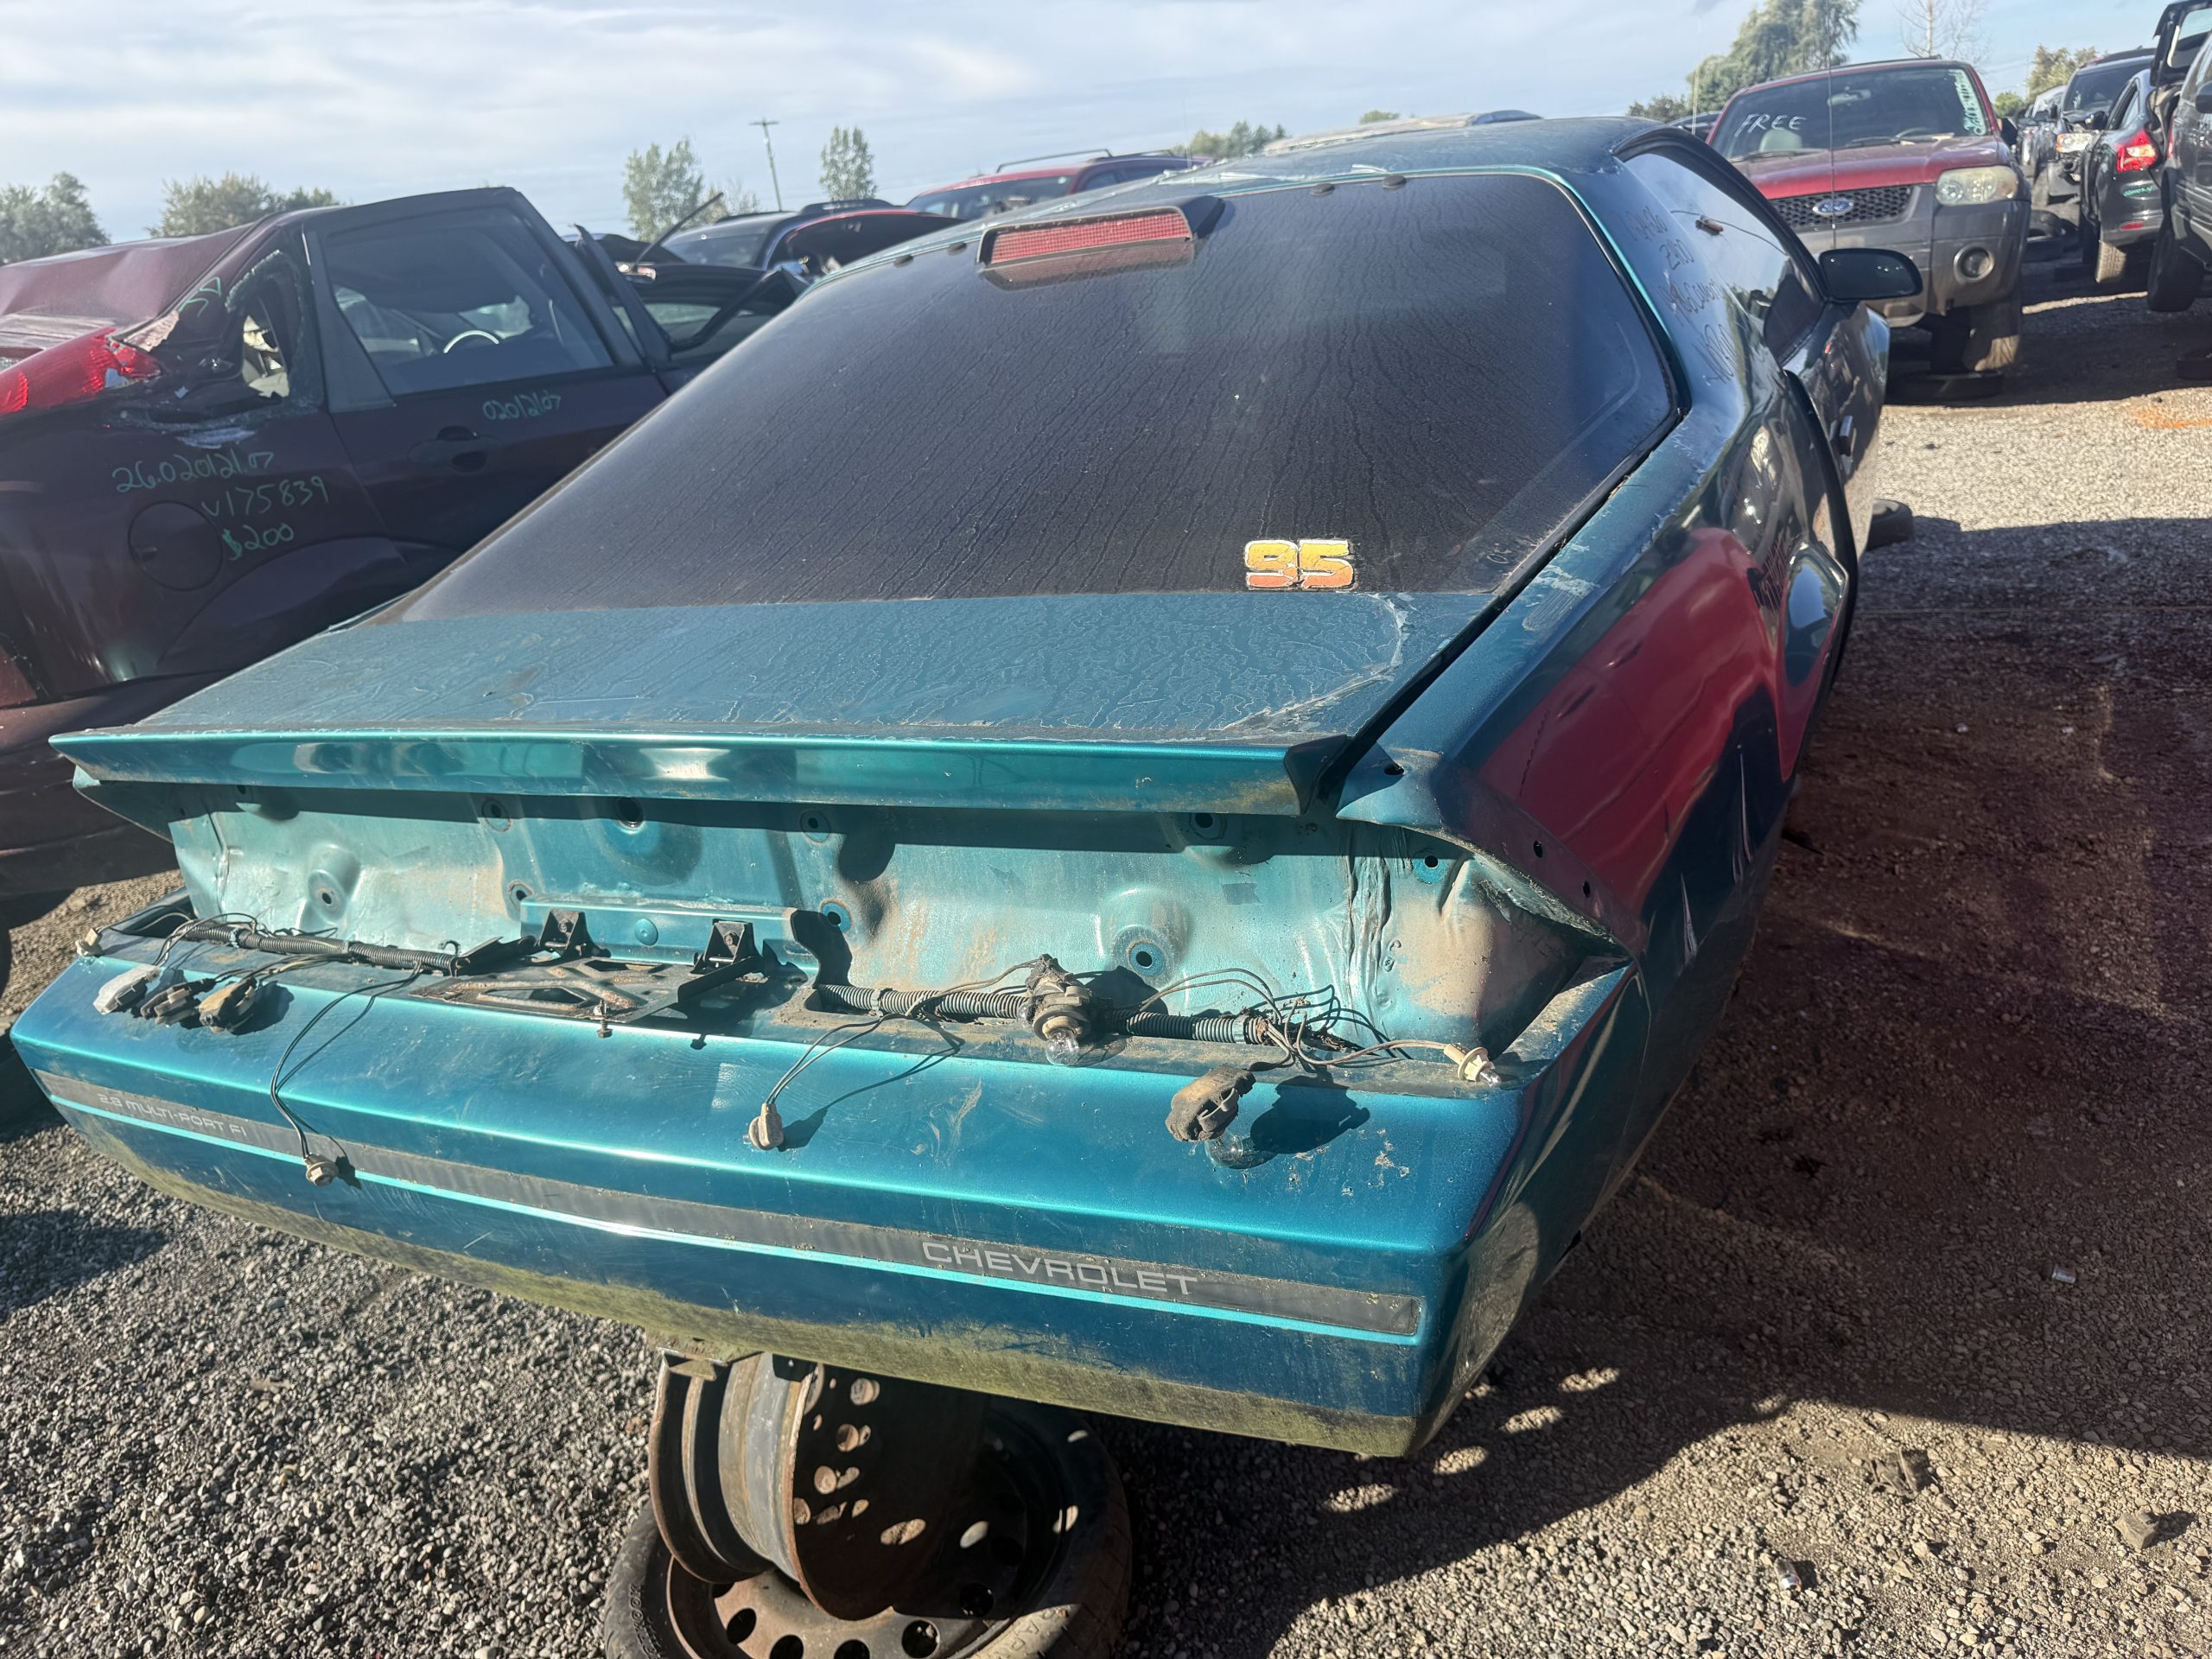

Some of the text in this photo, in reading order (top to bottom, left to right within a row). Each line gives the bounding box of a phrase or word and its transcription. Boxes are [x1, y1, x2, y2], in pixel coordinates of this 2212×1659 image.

[1733, 113, 1807, 138] FREE
[222, 522, 294, 561] $200
[1244, 539, 1355, 590] 95
[126, 1100, 225, 1132] MULTI-PORT
[229, 1124, 247, 1137] FI
[922, 1242, 1198, 1295] CHEVROLET
